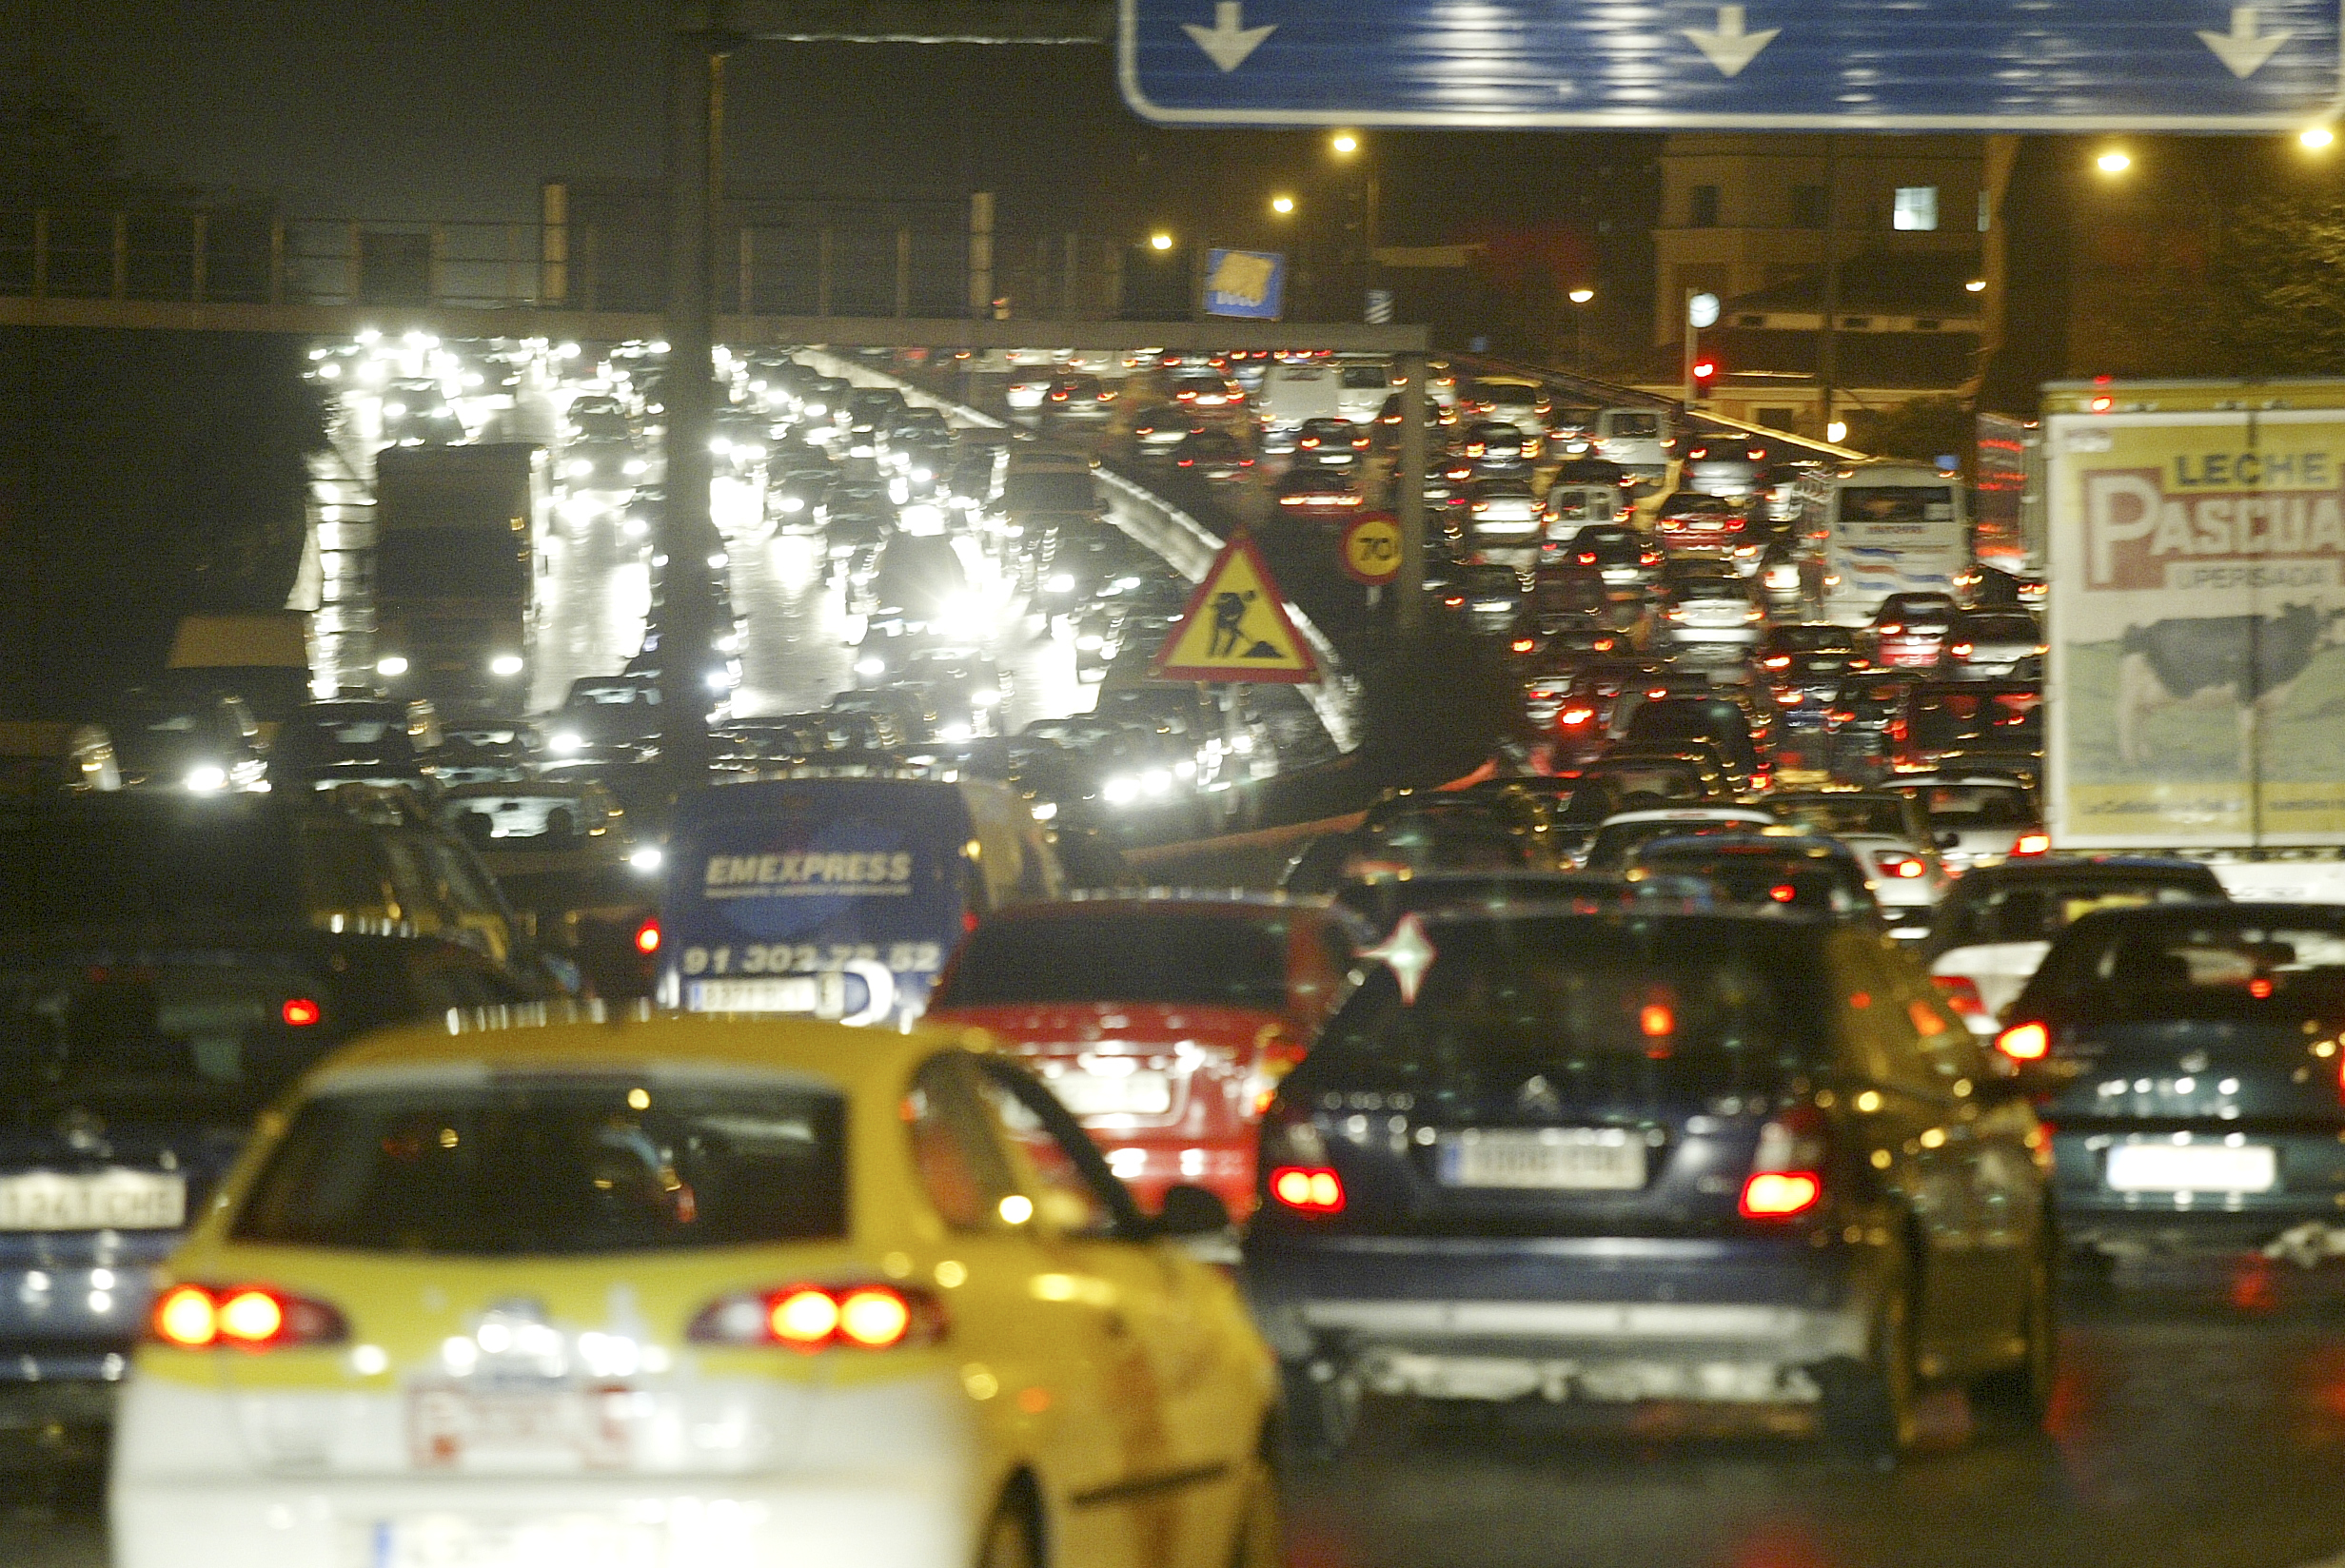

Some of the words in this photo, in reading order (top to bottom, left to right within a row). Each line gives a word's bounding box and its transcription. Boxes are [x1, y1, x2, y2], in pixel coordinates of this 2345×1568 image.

[2174, 452, 2329, 486] LECHE
[1358, 537, 1397, 561] 70
[705, 853, 911, 885] EMEXPRESS
[682, 946, 731, 974] 91
[740, 945, 818, 973] 302
